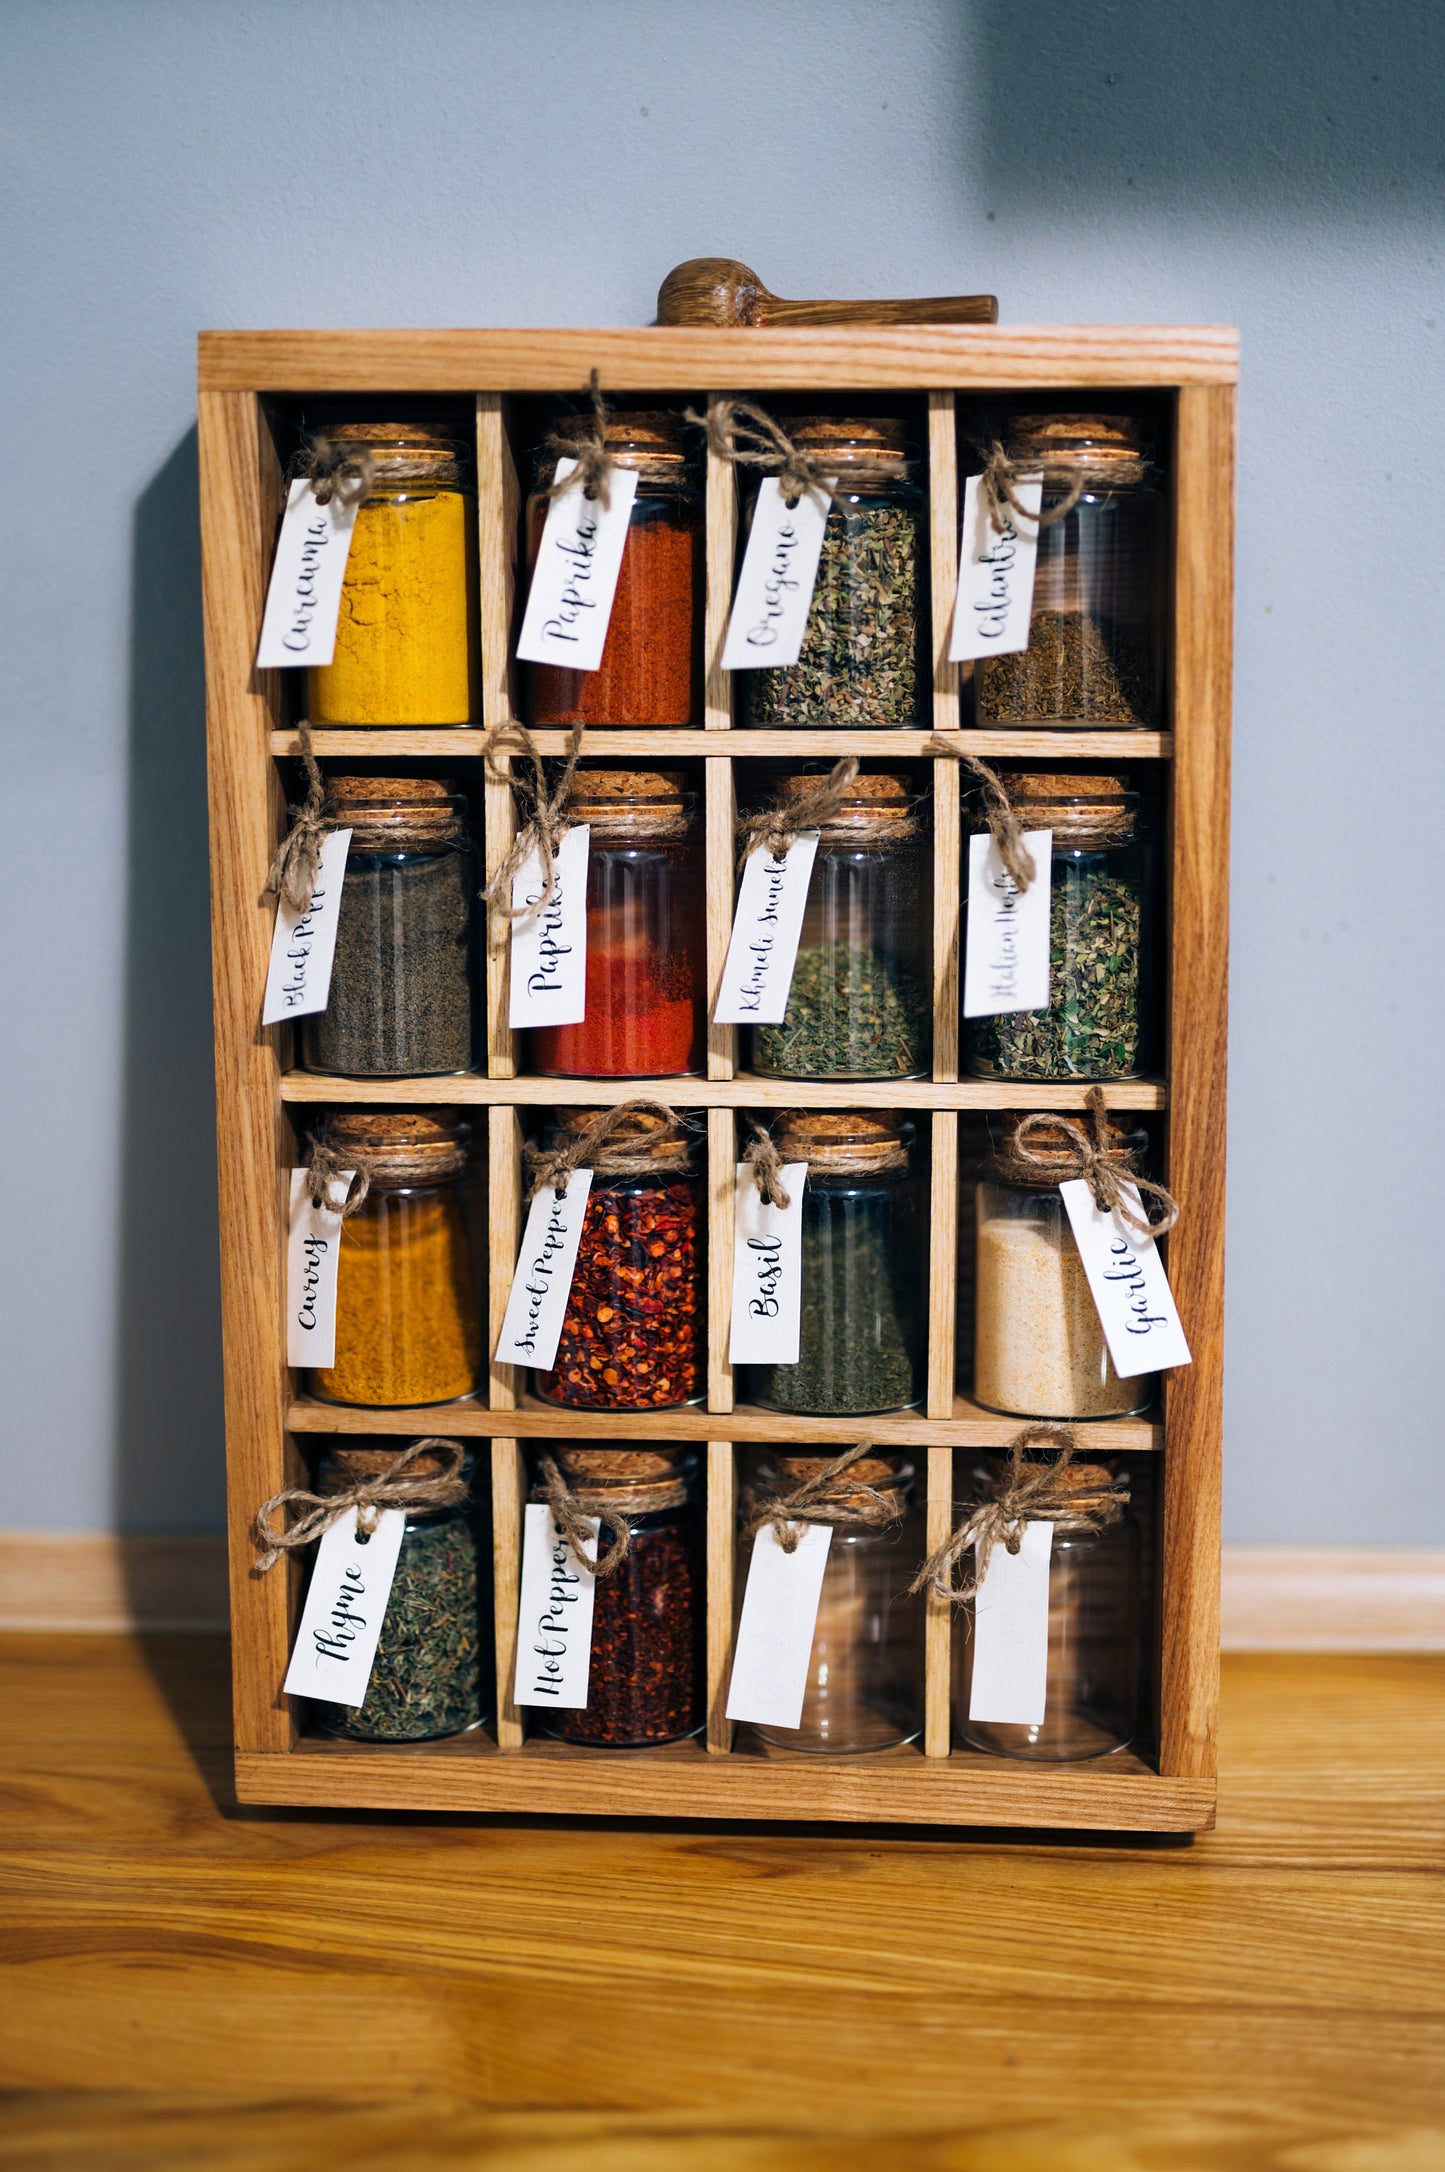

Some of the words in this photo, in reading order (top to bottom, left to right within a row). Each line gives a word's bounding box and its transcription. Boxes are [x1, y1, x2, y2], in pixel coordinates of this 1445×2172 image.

[283, 516, 328, 653] Curcuma
[541, 516, 598, 643] Paprika
[746, 519, 799, 647] Oregano
[281, 940, 312, 1010] Black
[738, 932, 775, 1012] Khmeli
[298, 1232, 328, 1331] Curry
[514, 1276, 548, 1358] Sweet
[748, 1234, 783, 1320] Basil
[1103, 1236, 1168, 1335] Garlic
[312, 1562, 367, 1670] Thyme
[538, 1538, 580, 1638] Pepper
[533, 1636, 568, 1696] Hot
